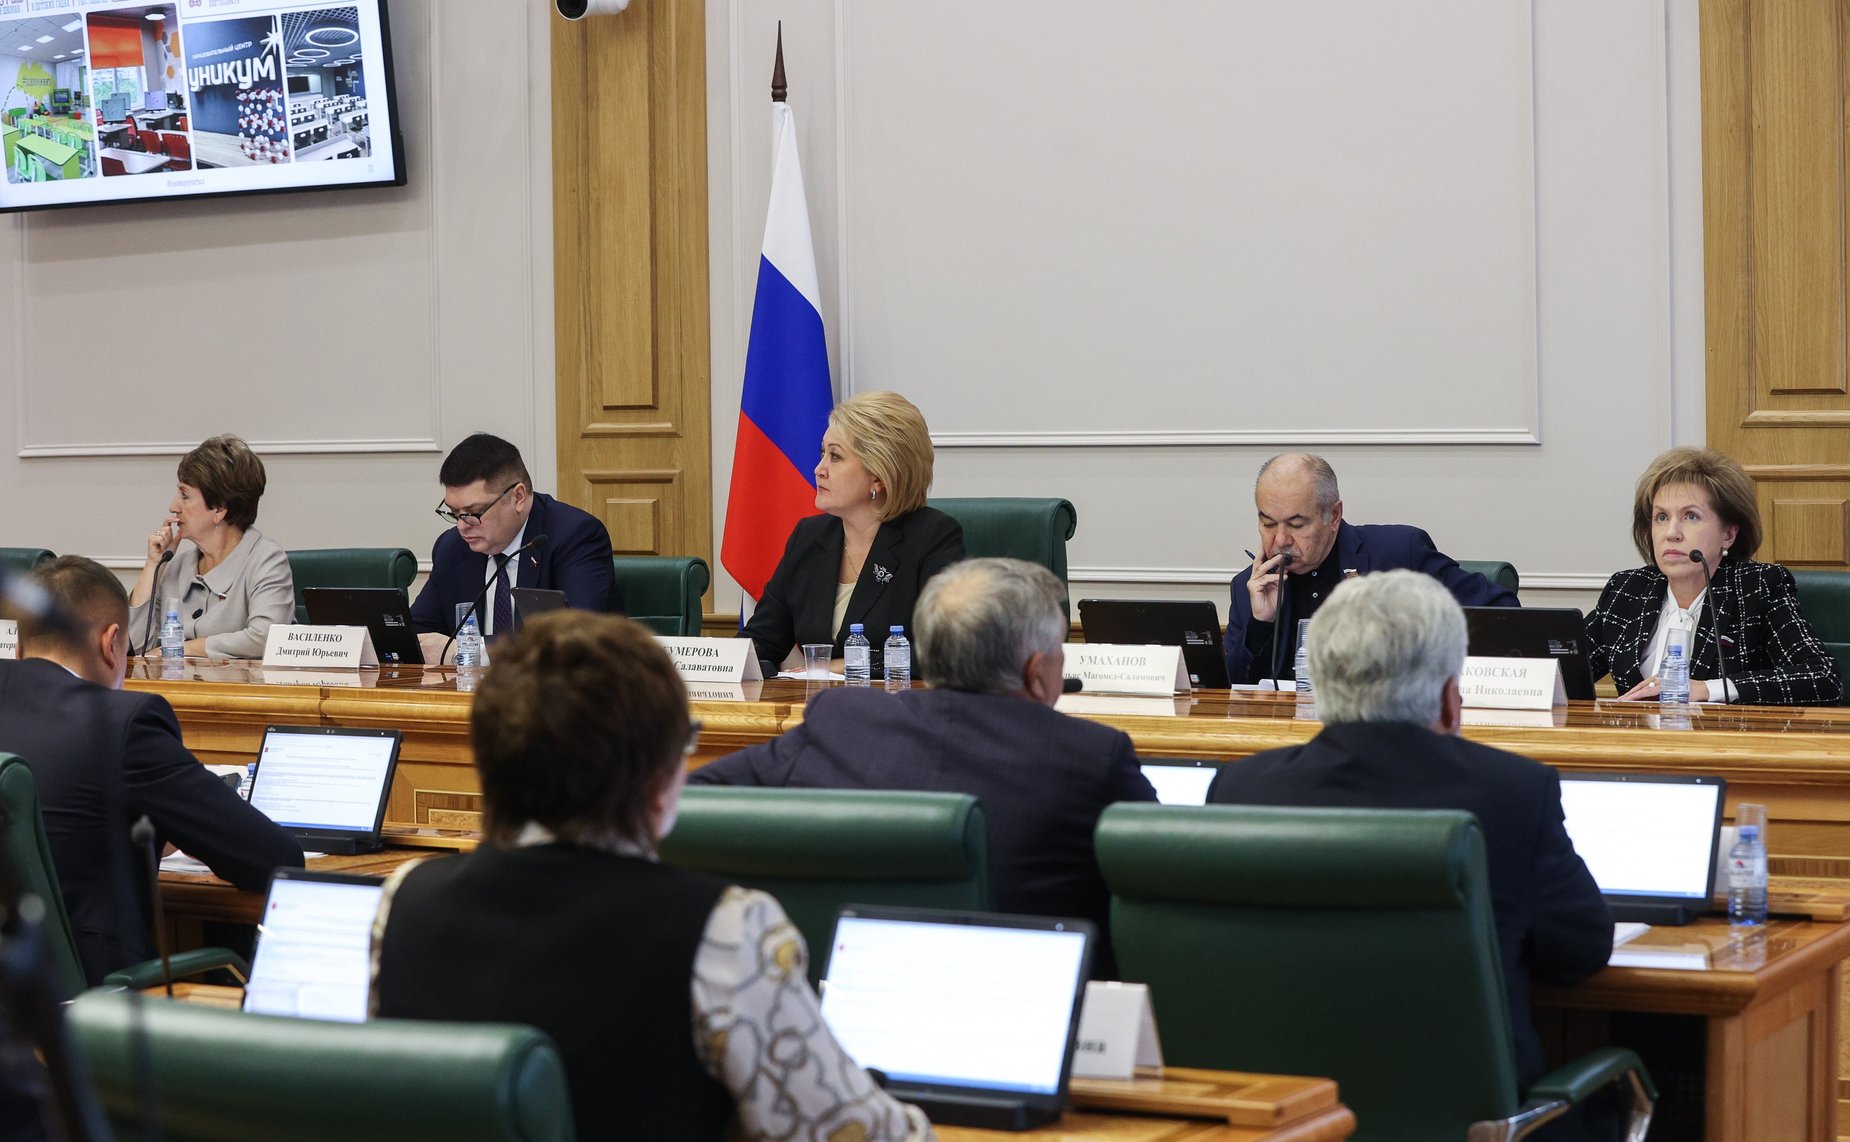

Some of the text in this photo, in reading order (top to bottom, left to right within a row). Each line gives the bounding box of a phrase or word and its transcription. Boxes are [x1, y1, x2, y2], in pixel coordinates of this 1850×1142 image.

[287, 632, 343, 643] ВАСИЛЕНКО
[275, 646, 348, 658] Дмитрий Юрьевич
[1079, 655, 1147, 666] УМАХАНОВ
[674, 661, 734, 673] Салаватовна
[1460, 666, 1528, 678] КОВСКАЯ
[1475, 684, 1543, 697] Николаевна
